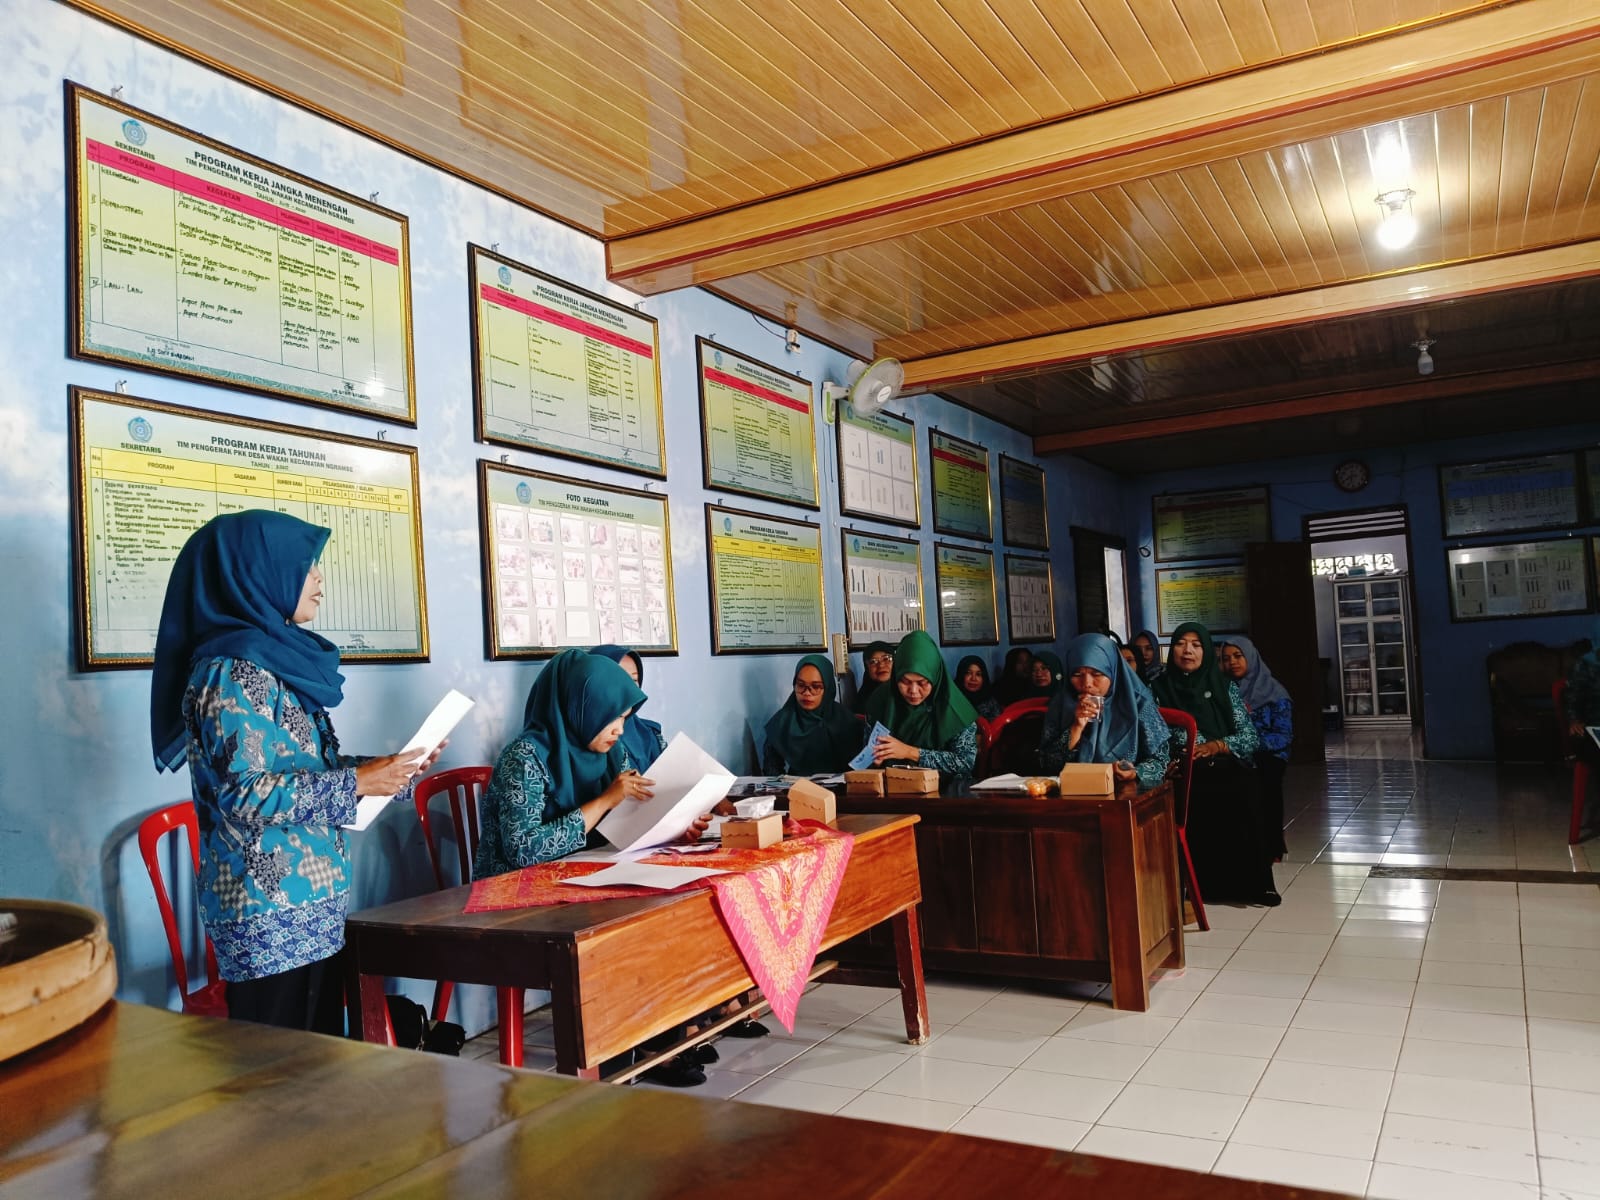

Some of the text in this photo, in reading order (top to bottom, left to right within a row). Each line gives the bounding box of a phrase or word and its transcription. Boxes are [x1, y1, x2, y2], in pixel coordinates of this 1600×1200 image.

[114, 140, 155, 160] SEKRETARIS
[119, 153, 155, 172] PROGRAM
[206, 184, 240, 202] KEGIATAN
[194, 150, 240, 175] PROGRAM
[242, 169, 268, 186] KERJA
[271, 179, 302, 198] JANGKA
[304, 192, 347, 215] MENENGAH
[185, 157, 196, 166] TIM
[198, 161, 238, 182] PENGGERAK
[239, 177, 252, 187] PKK
[253, 182, 269, 193] DESA
[270, 188, 292, 202] WAKAH
[293, 197, 327, 215] KECAMATAN
[328, 210, 354, 225] NGRAMBE
[255, 191, 274, 203] TAHUN
[536, 284, 562, 299] PROGRAM
[120, 442, 161, 454] SEKRETARIS
[176, 440, 353, 472] TIM PENGGERAK PKK DESA WAKAH KECAMATAN NGRAMBE
[211, 436, 326, 461] PROGRAM KERJA TAHUNAN
[147, 461, 174, 471] PROGRAM
[251, 460, 270, 468] TAHUN
[566, 493, 608, 506] FOTO KEGIATAN
